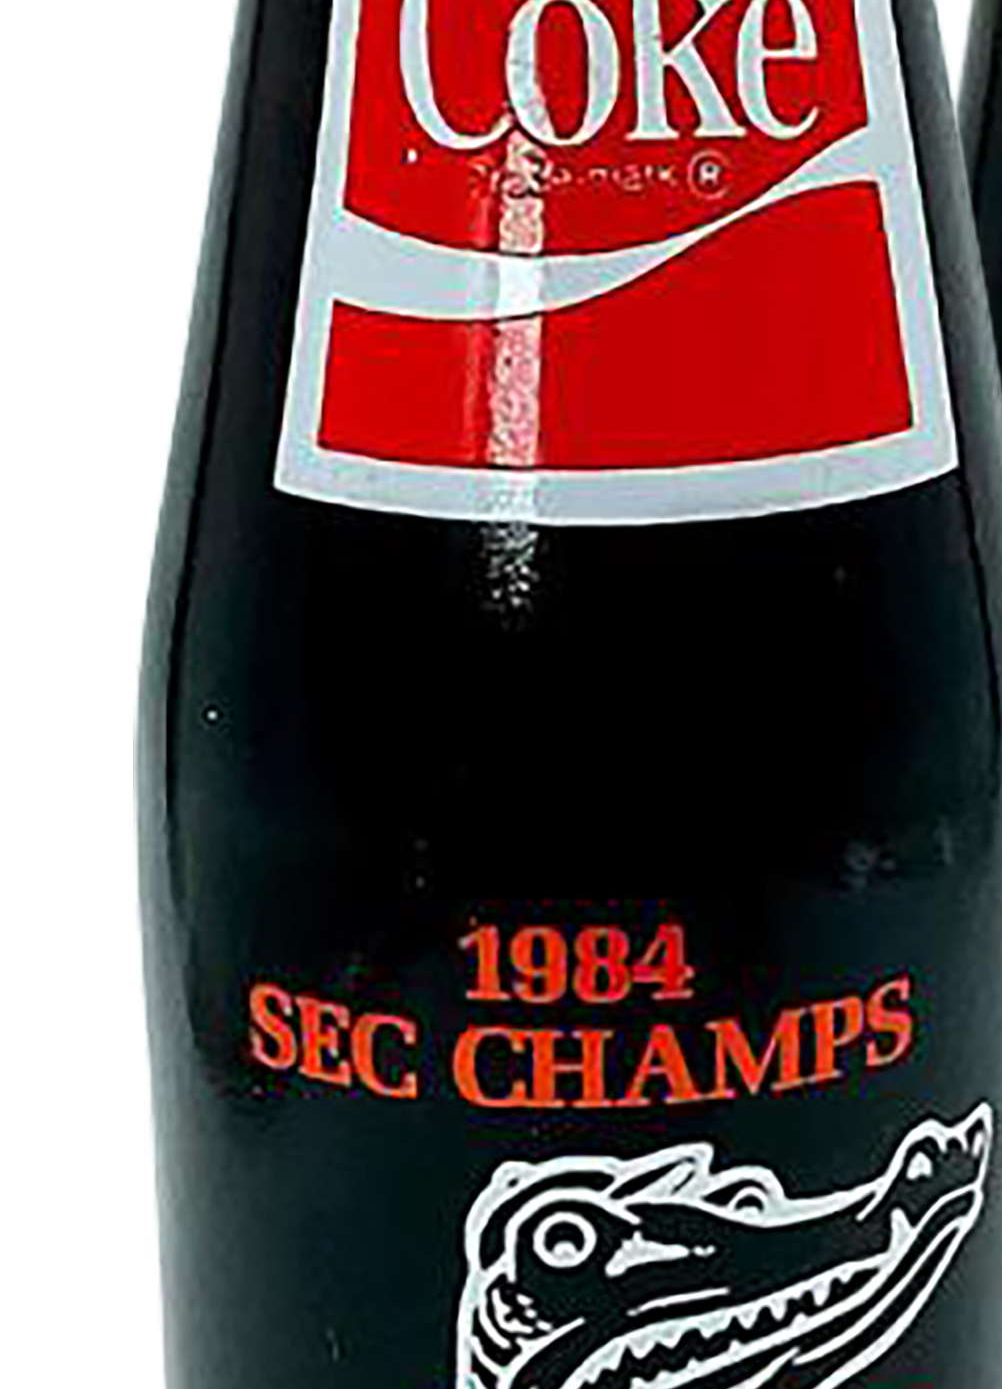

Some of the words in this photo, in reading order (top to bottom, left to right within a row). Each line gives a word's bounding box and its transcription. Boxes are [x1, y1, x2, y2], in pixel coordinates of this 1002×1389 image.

[459, 923, 696, 1004] 1984
[248, 982, 418, 1100] SEC
[452, 975, 914, 1110] CHAMPS
